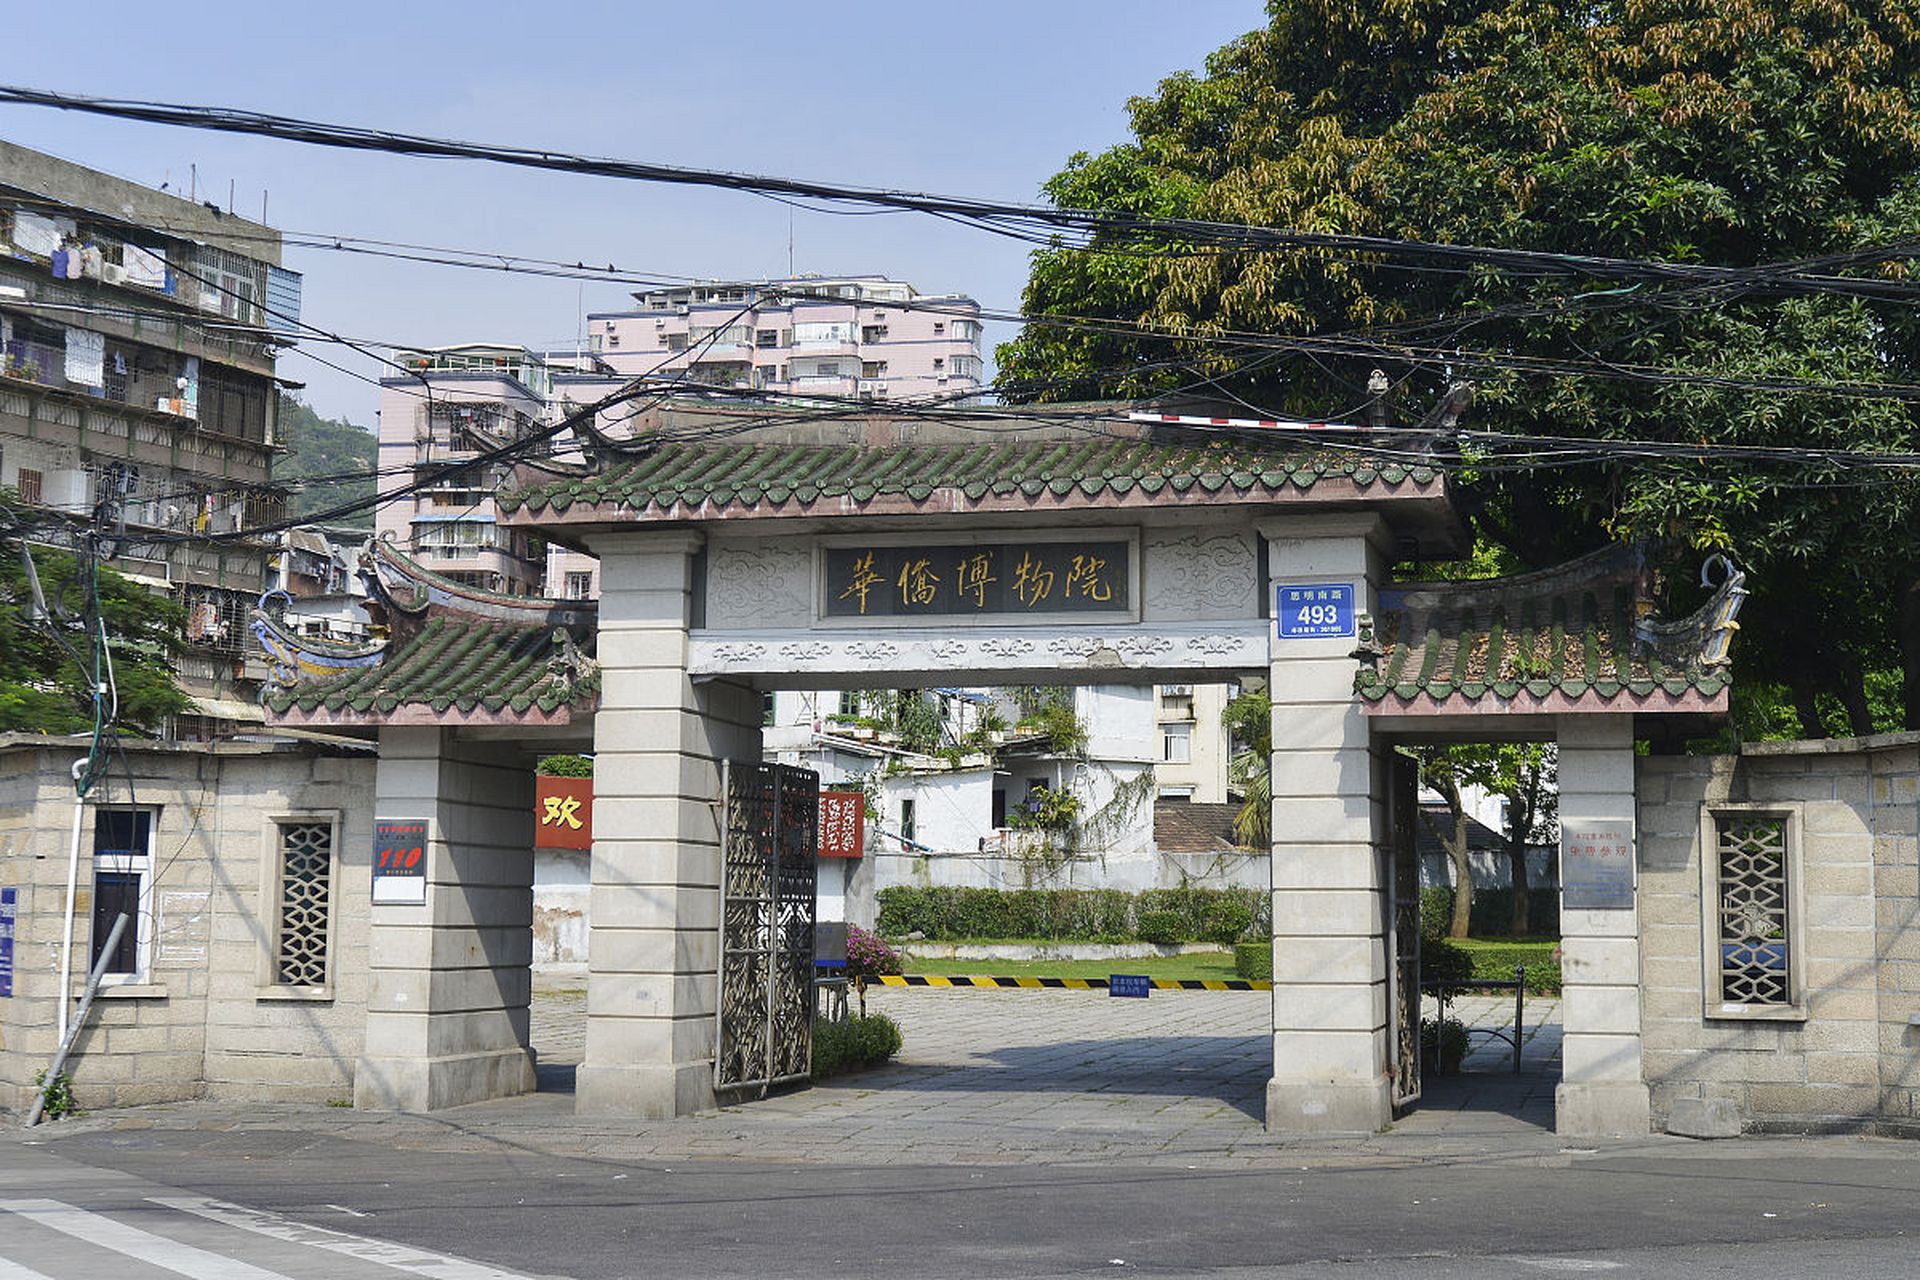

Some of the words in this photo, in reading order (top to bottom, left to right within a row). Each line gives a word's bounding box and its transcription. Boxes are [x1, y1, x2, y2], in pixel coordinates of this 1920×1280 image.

[838, 549, 1112, 614] 華僑博物院
[1297, 604, 1338, 625] 493
[541, 795, 583, 830] 欢
[378, 847, 422, 868] 110
